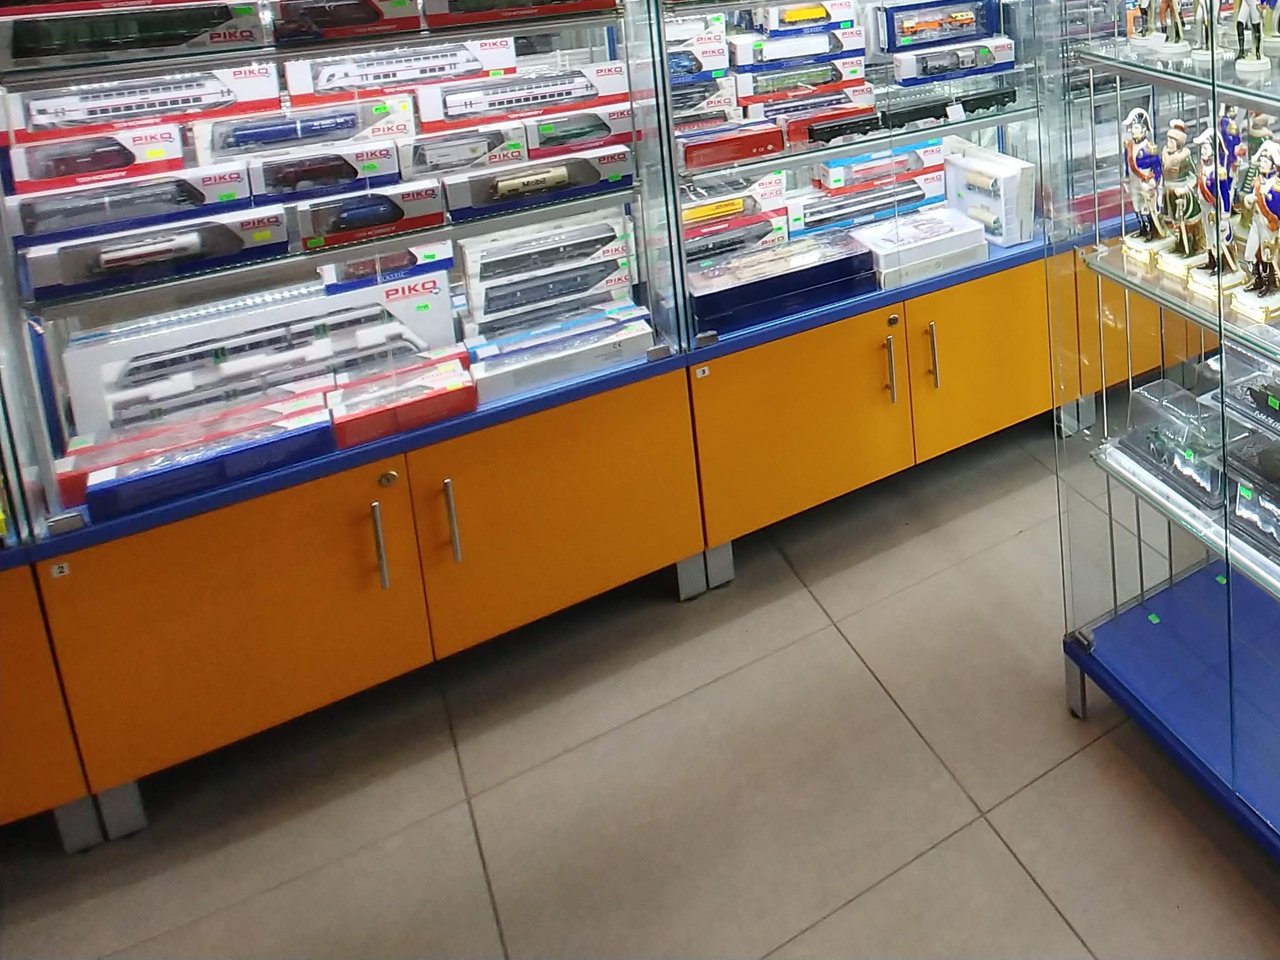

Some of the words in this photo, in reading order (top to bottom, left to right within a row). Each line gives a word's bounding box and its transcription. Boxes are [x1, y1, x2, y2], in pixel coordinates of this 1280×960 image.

[210, 30, 253, 42] PIKO
[480, 41, 508, 50] PIKO
[233, 68, 269, 78] PIKO
[596, 67, 622, 75] PIKO
[706, 98, 731, 106] PIKO
[372, 124, 407, 135] PIKO
[132, 132, 172, 145] PIKO
[355, 150, 389, 160] PIKO
[489, 151, 519, 161] PIKO
[598, 154, 627, 163] PIKO
[202, 173, 241, 185] PIKO
[521, 177, 547, 187] Mobil
[758, 180, 782, 188] PIKO
[401, 191, 435, 201] PIKO
[240, 217, 278, 229] PIKO
[761, 236, 784, 245] PIKO
[386, 280, 437, 299] PIKO
